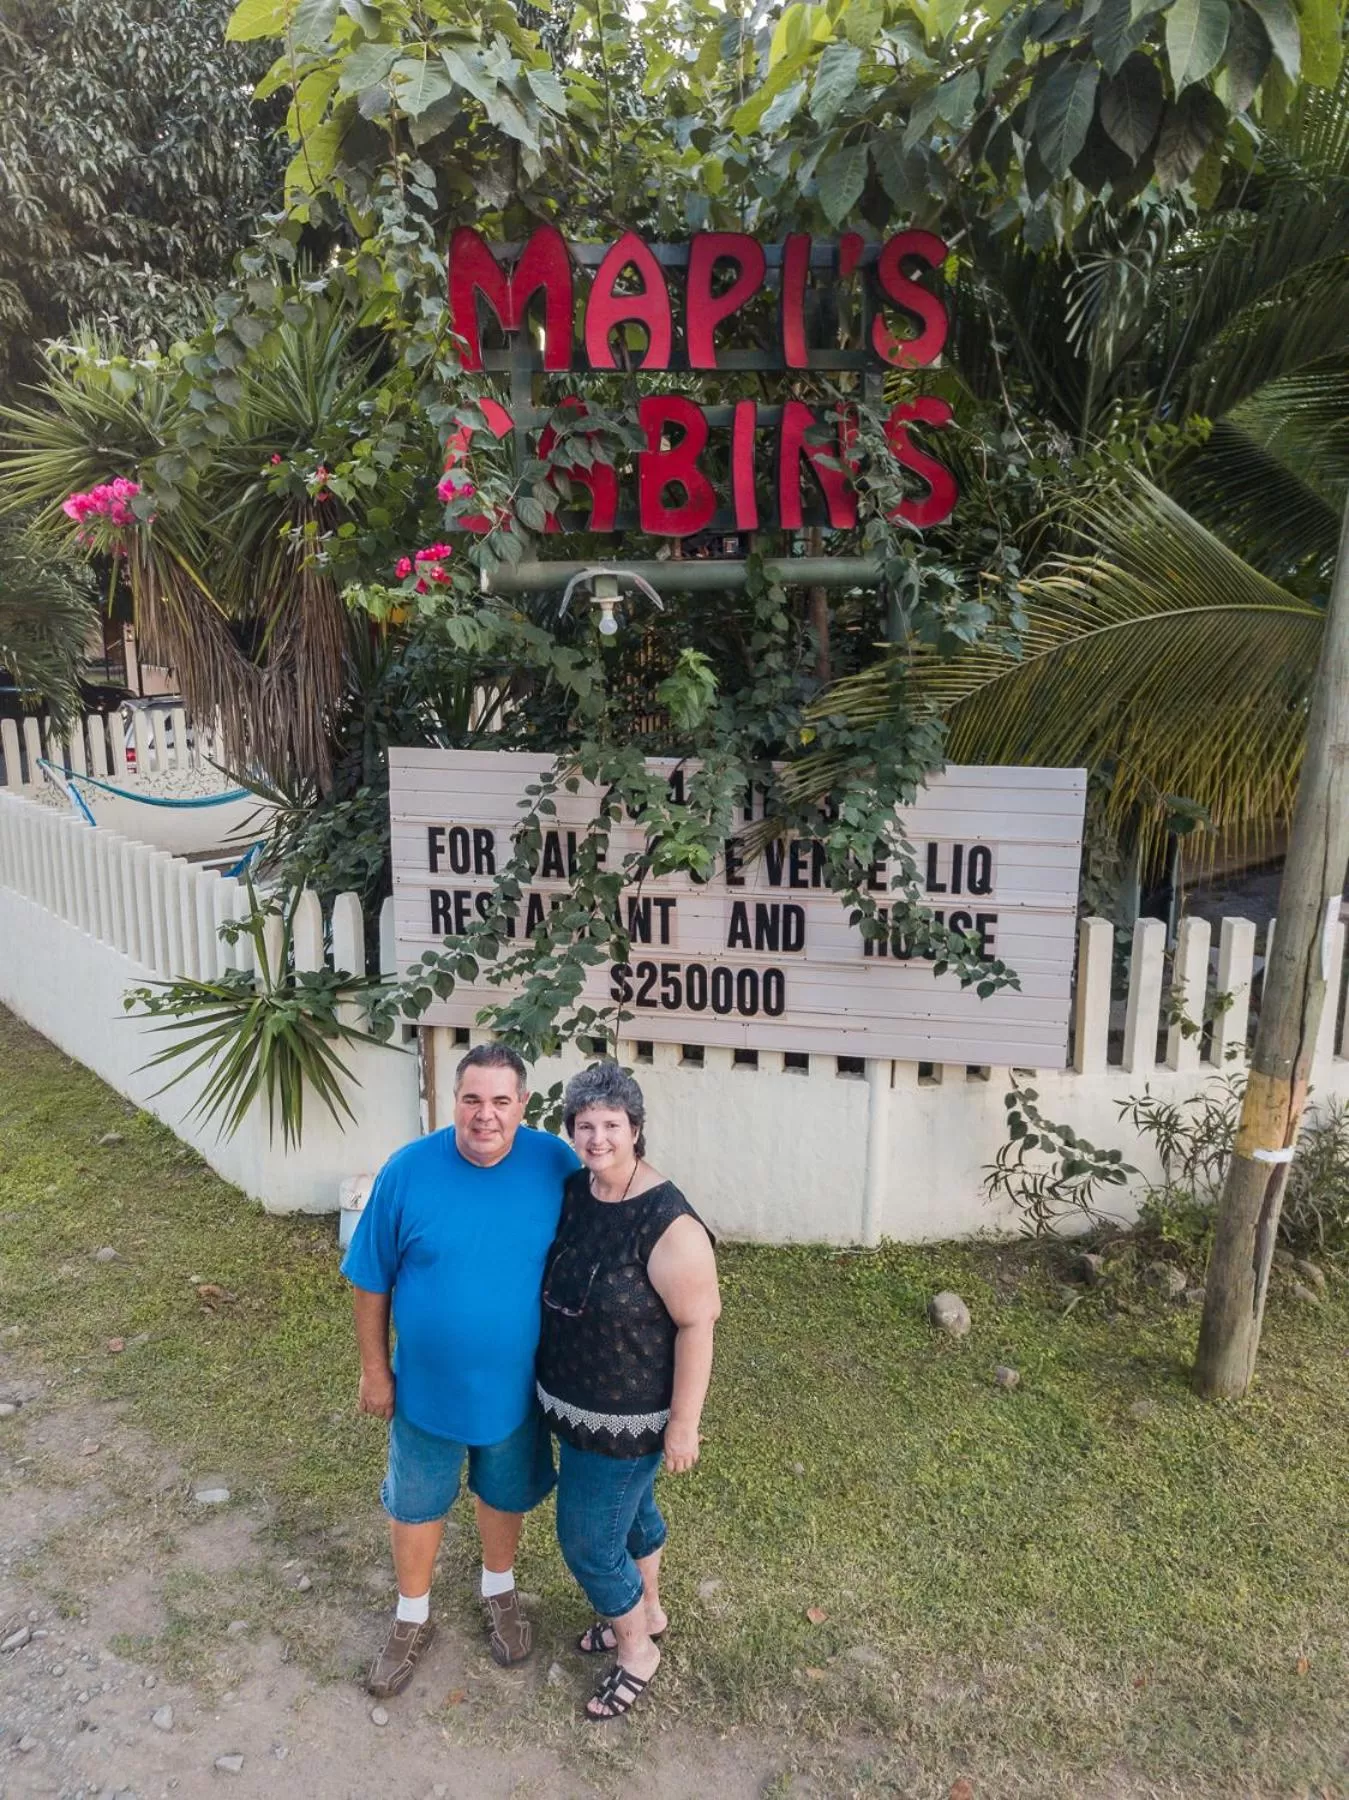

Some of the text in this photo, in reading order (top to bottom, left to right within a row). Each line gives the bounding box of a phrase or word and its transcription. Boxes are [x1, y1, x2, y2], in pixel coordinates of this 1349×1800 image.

[448, 225, 949, 372] MAPI'S
[428, 826, 496, 875] FOR
[764, 837, 888, 892] VENE
[925, 842, 993, 896] LIQ
[727, 901, 806, 952] AND
[610, 961, 786, 1017] $250000
